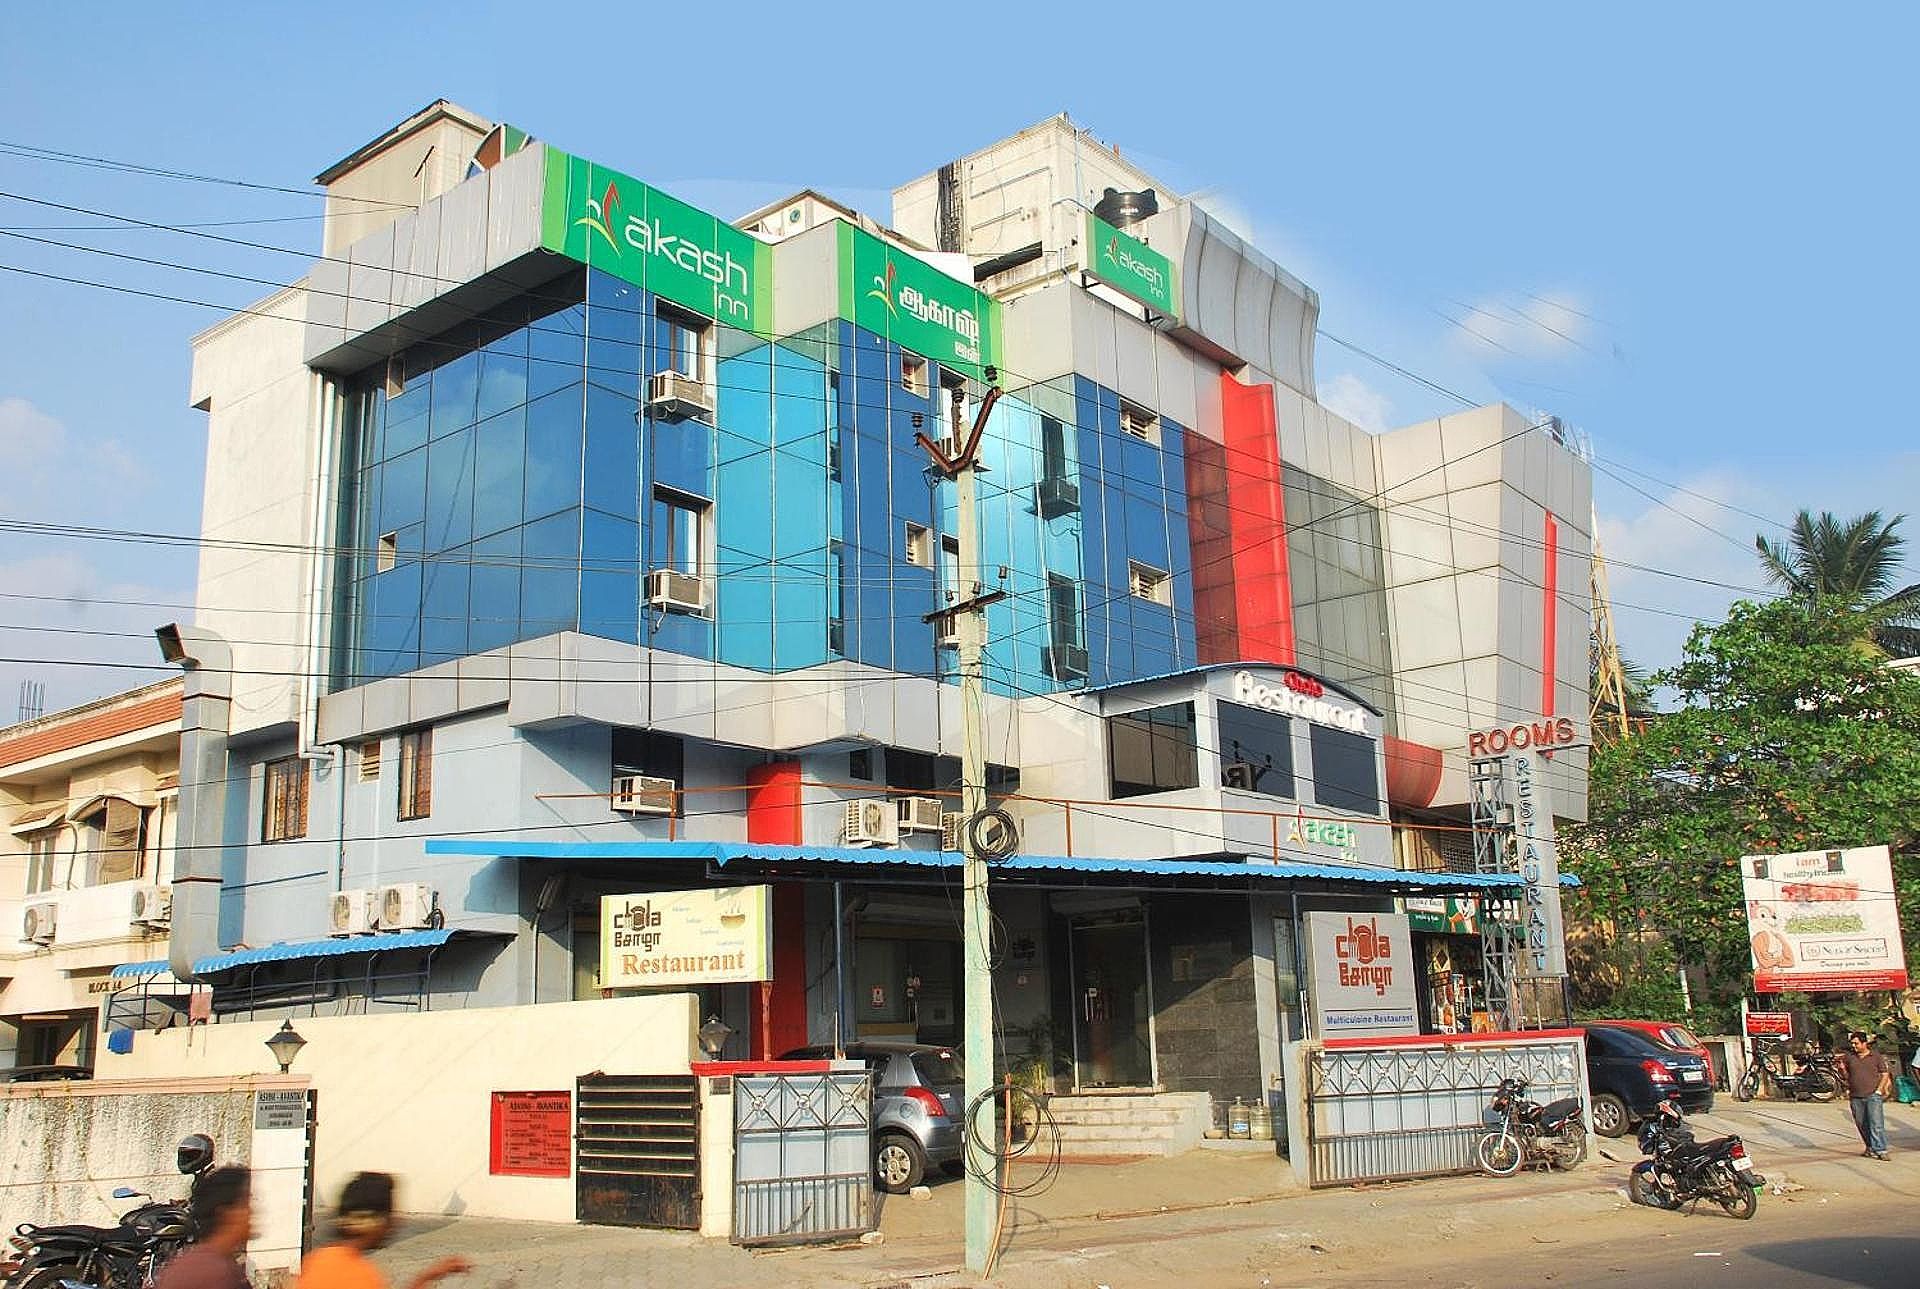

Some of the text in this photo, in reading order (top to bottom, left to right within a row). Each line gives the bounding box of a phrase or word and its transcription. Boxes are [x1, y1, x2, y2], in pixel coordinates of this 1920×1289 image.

[624, 215, 748, 296] akash
[1119, 251, 1163, 289] akash
[1468, 717, 1576, 757] ROOMS
[1515, 757, 1546, 970] RESTAURANT
[622, 950, 746, 976] Restaurant
[1374, 1013, 1413, 1024] Restaurant
